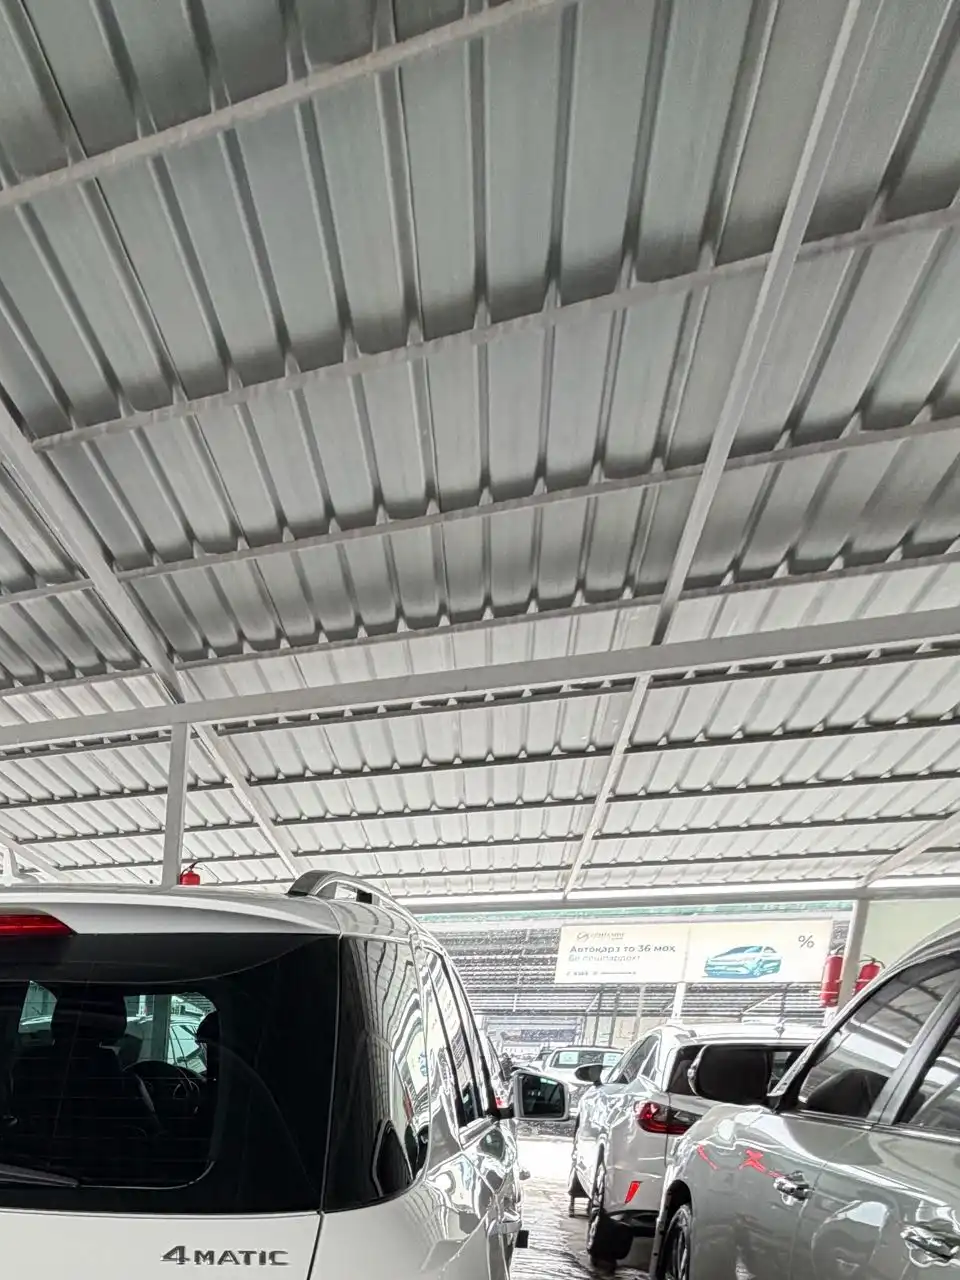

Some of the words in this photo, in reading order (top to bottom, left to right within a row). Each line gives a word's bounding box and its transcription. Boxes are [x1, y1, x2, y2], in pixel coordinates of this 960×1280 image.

[638, 944, 652, 953] 36
[798, 934, 815, 949] %
[160, 1245, 290, 1266] 4MATIC
